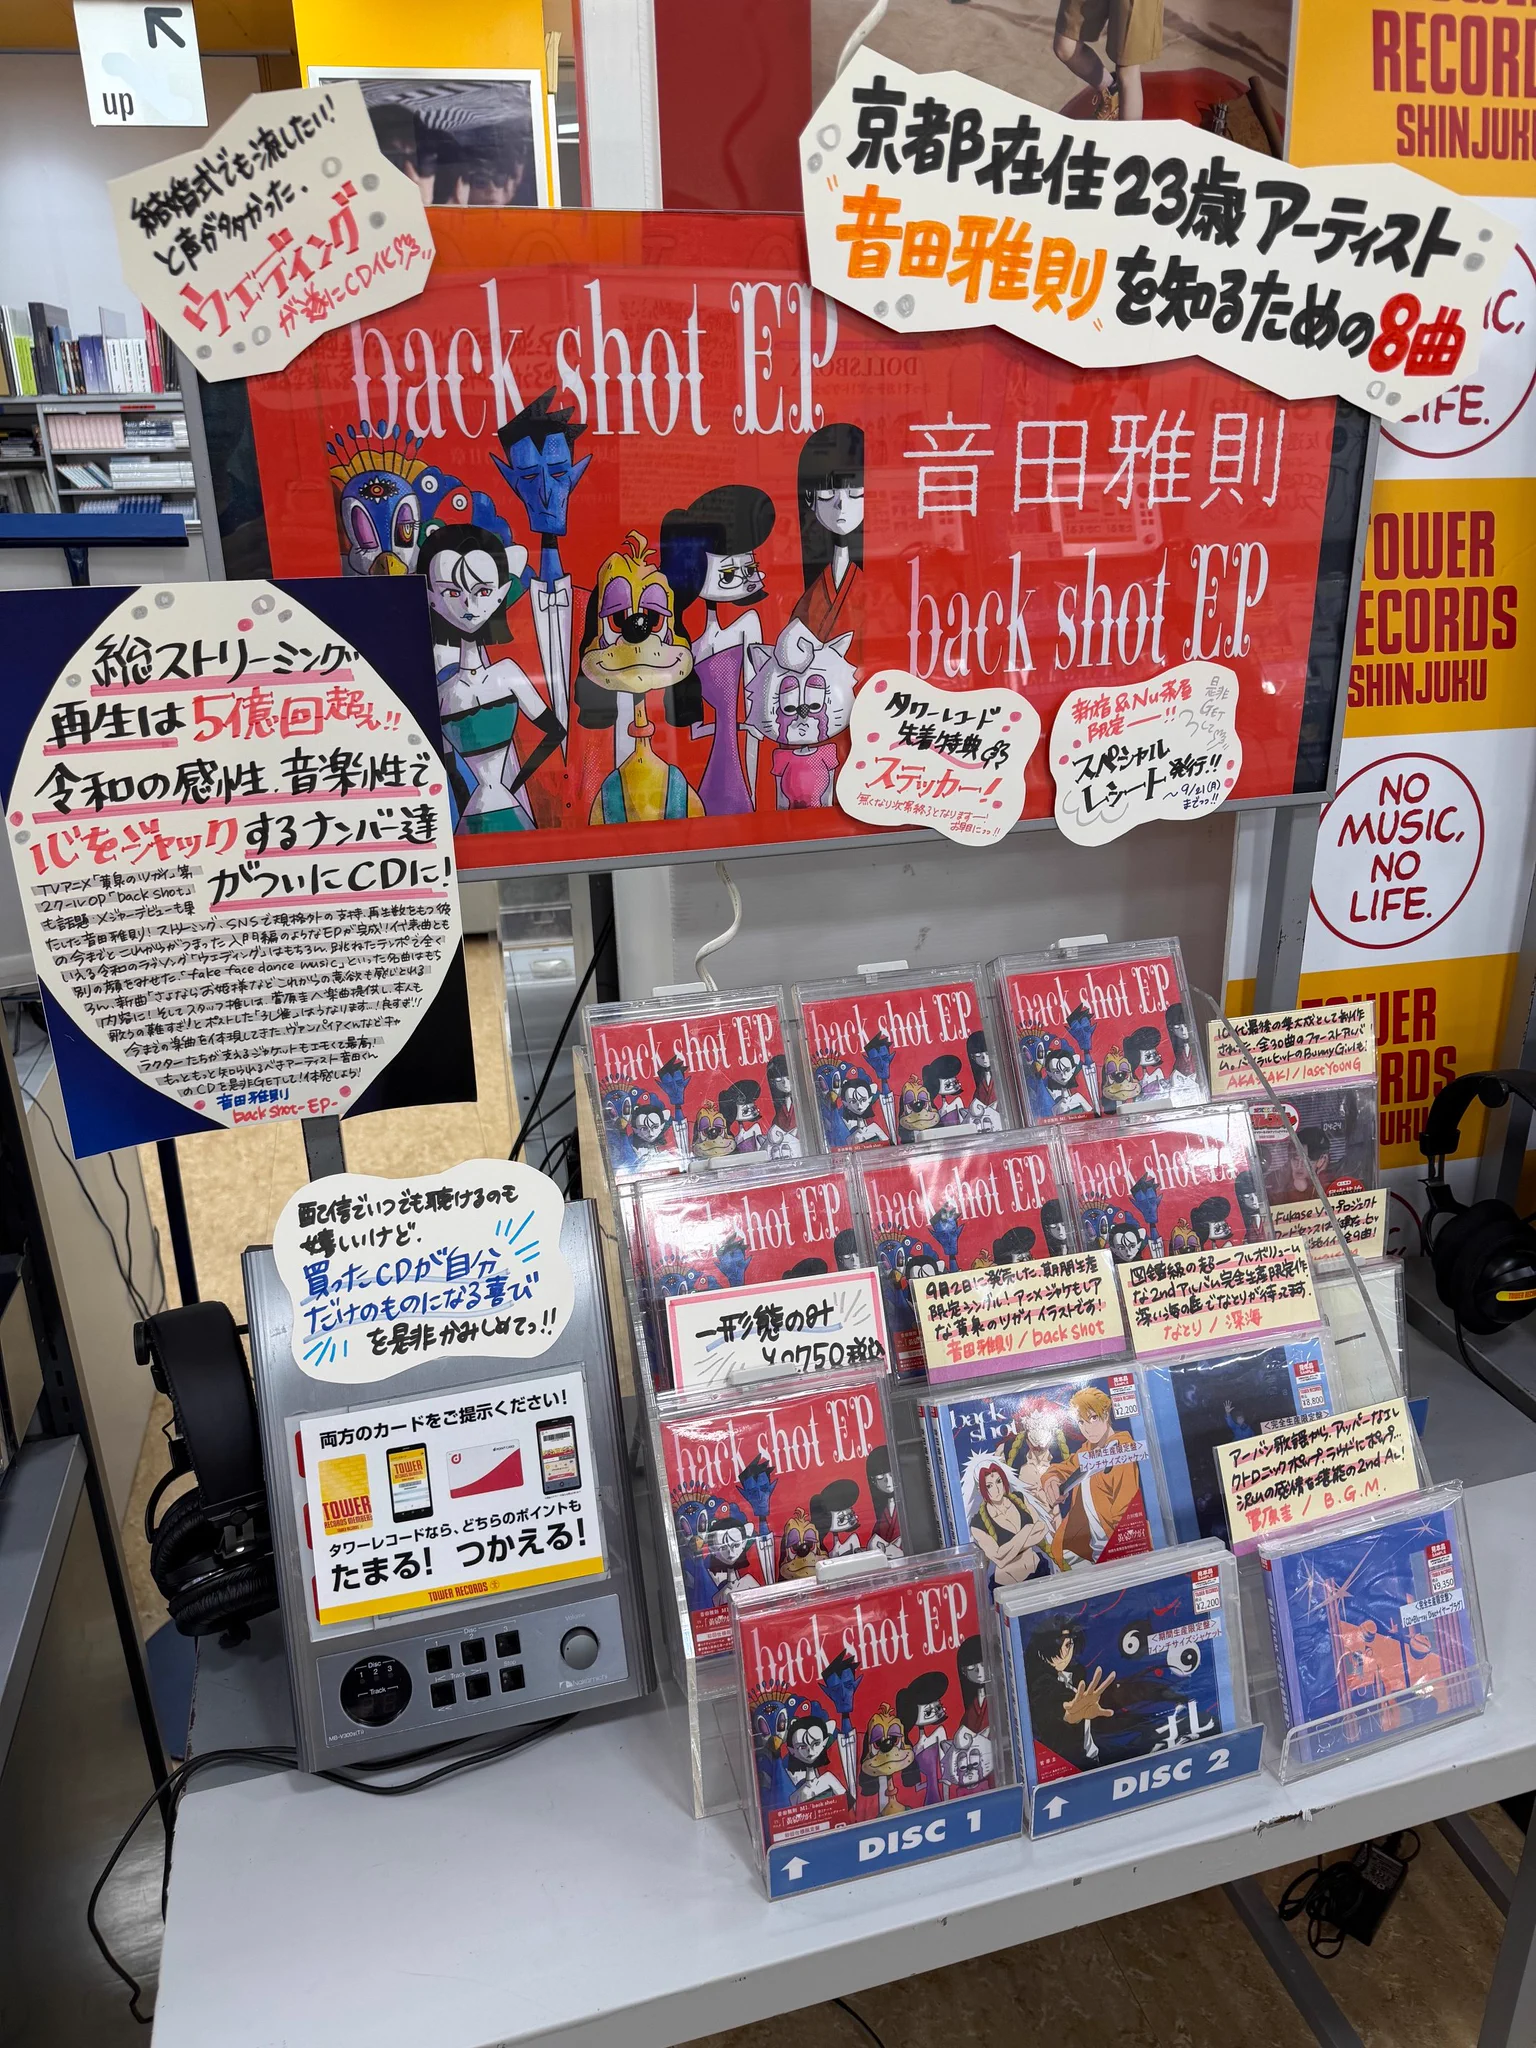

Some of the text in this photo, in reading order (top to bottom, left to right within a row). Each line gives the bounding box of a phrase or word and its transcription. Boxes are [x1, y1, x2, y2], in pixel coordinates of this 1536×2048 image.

[102, 92, 134, 121] up
[351, 278, 523, 440] back
[555, 278, 711, 437] shot
[729, 281, 839, 436] EP
[903, 409, 1286, 521] 音田雅則
[906, 540, 1270, 680] back shot EP
[1354, 585, 1518, 657] ECORDS
[1348, 658, 1488, 708] SHINJUKU
[1379, 771, 1430, 805] NO
[1337, 805, 1466, 847] MUSIC,
[1370, 850, 1421, 884] NO
[1349, 886, 1433, 923] LIFE.
[877, 1000, 934, 1050] shot
[932, 990, 972, 1043] EP
[1079, 971, 1133, 1021] shot
[1131, 962, 1170, 1014] EP
[673, 1019, 732, 1073] shot
[732, 1012, 774, 1068] EP
[216, 1088, 289, 1111] 音田雅則
[1003, 1154, 1047, 1211] EP
[797, 1182, 841, 1243] EP
[318, 1389, 568, 1450] 両方のカードをご提示ください!
[672, 1394, 874, 1493] back shot EP
[393, 1459, 423, 1475] TOWER
[322, 1495, 373, 1521] TOWER
[330, 1517, 586, 1593] たまる! つかえる!
[751, 1614, 835, 1697] back
[842, 1596, 914, 1671] shot
[916, 1582, 968, 1656] EP
[1112, 1748, 1230, 1801] DISC 2
[858, 1809, 982, 1862] DISC 1
